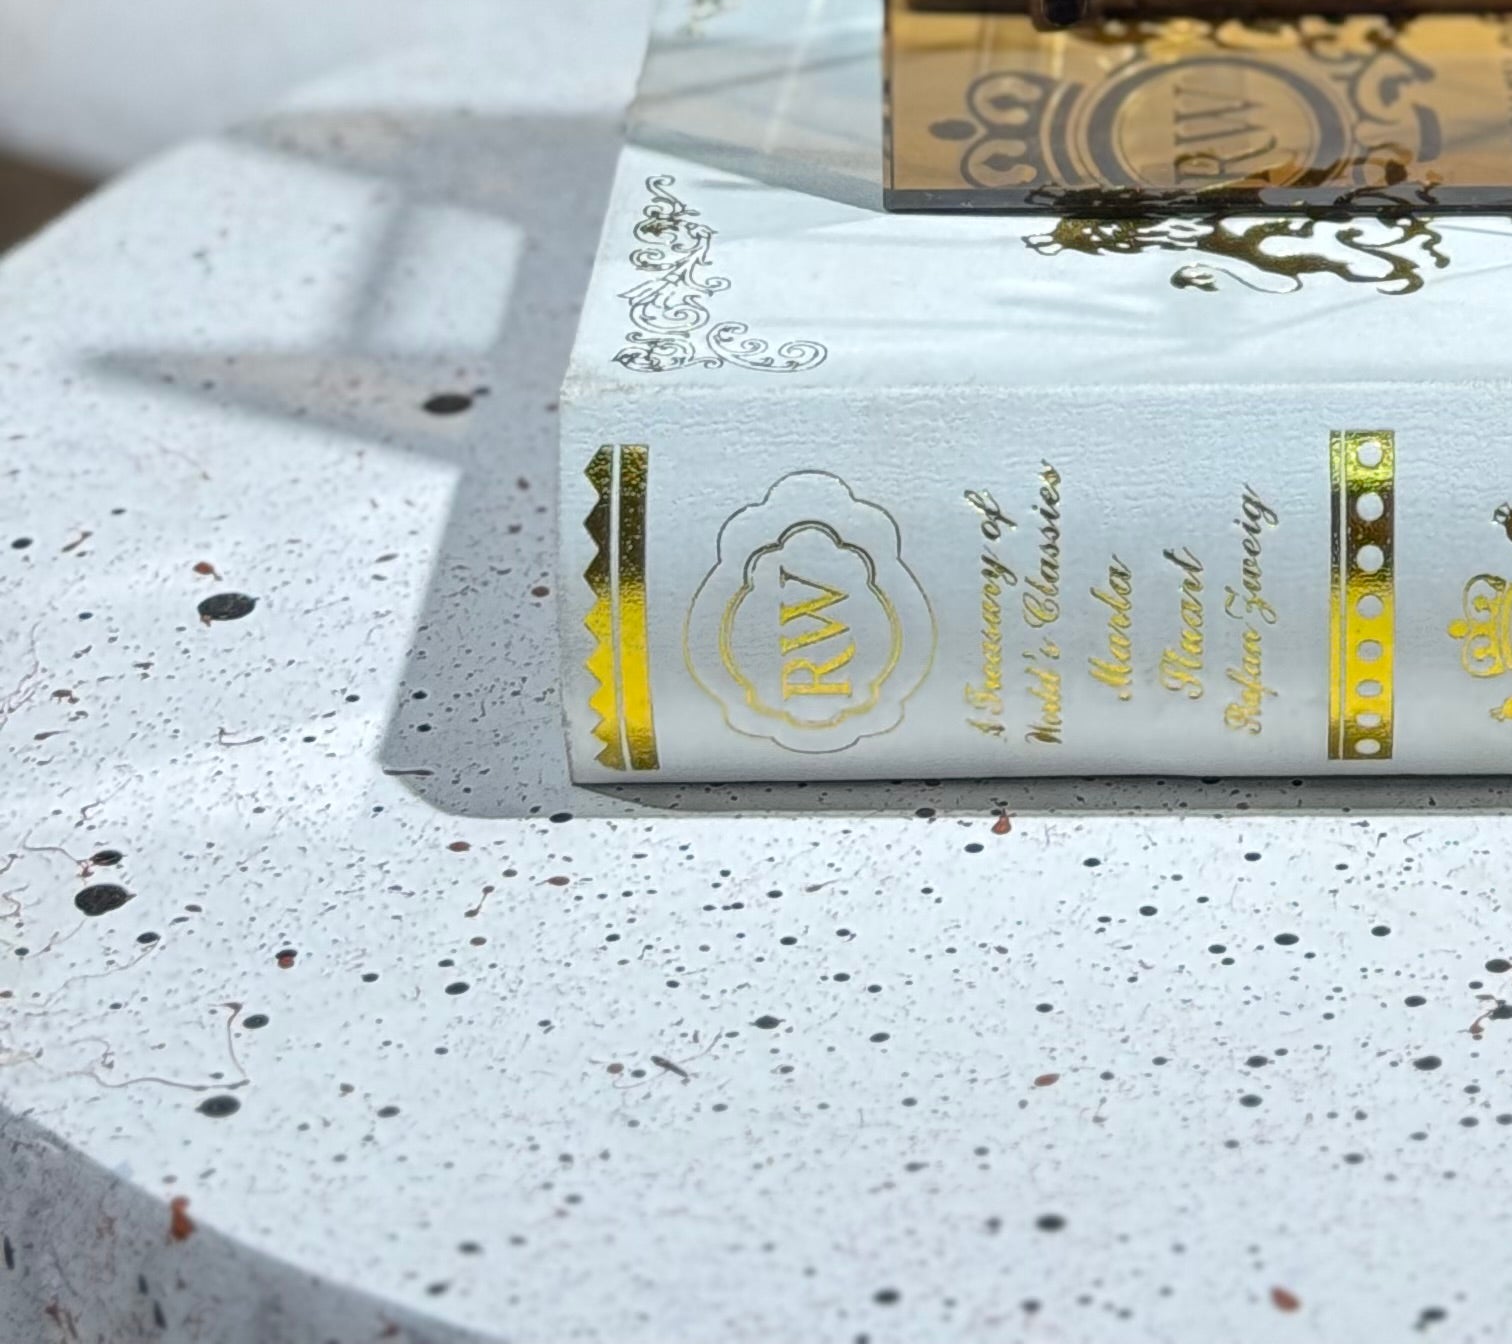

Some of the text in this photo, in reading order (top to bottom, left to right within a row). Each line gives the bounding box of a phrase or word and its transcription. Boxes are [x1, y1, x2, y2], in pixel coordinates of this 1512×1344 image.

[1172, 84, 1278, 187] RW
[963, 488, 1018, 541] of
[1224, 483, 1279, 625] Zweig
[777, 565, 857, 701] RW
[964, 543, 1018, 715] Treasury
